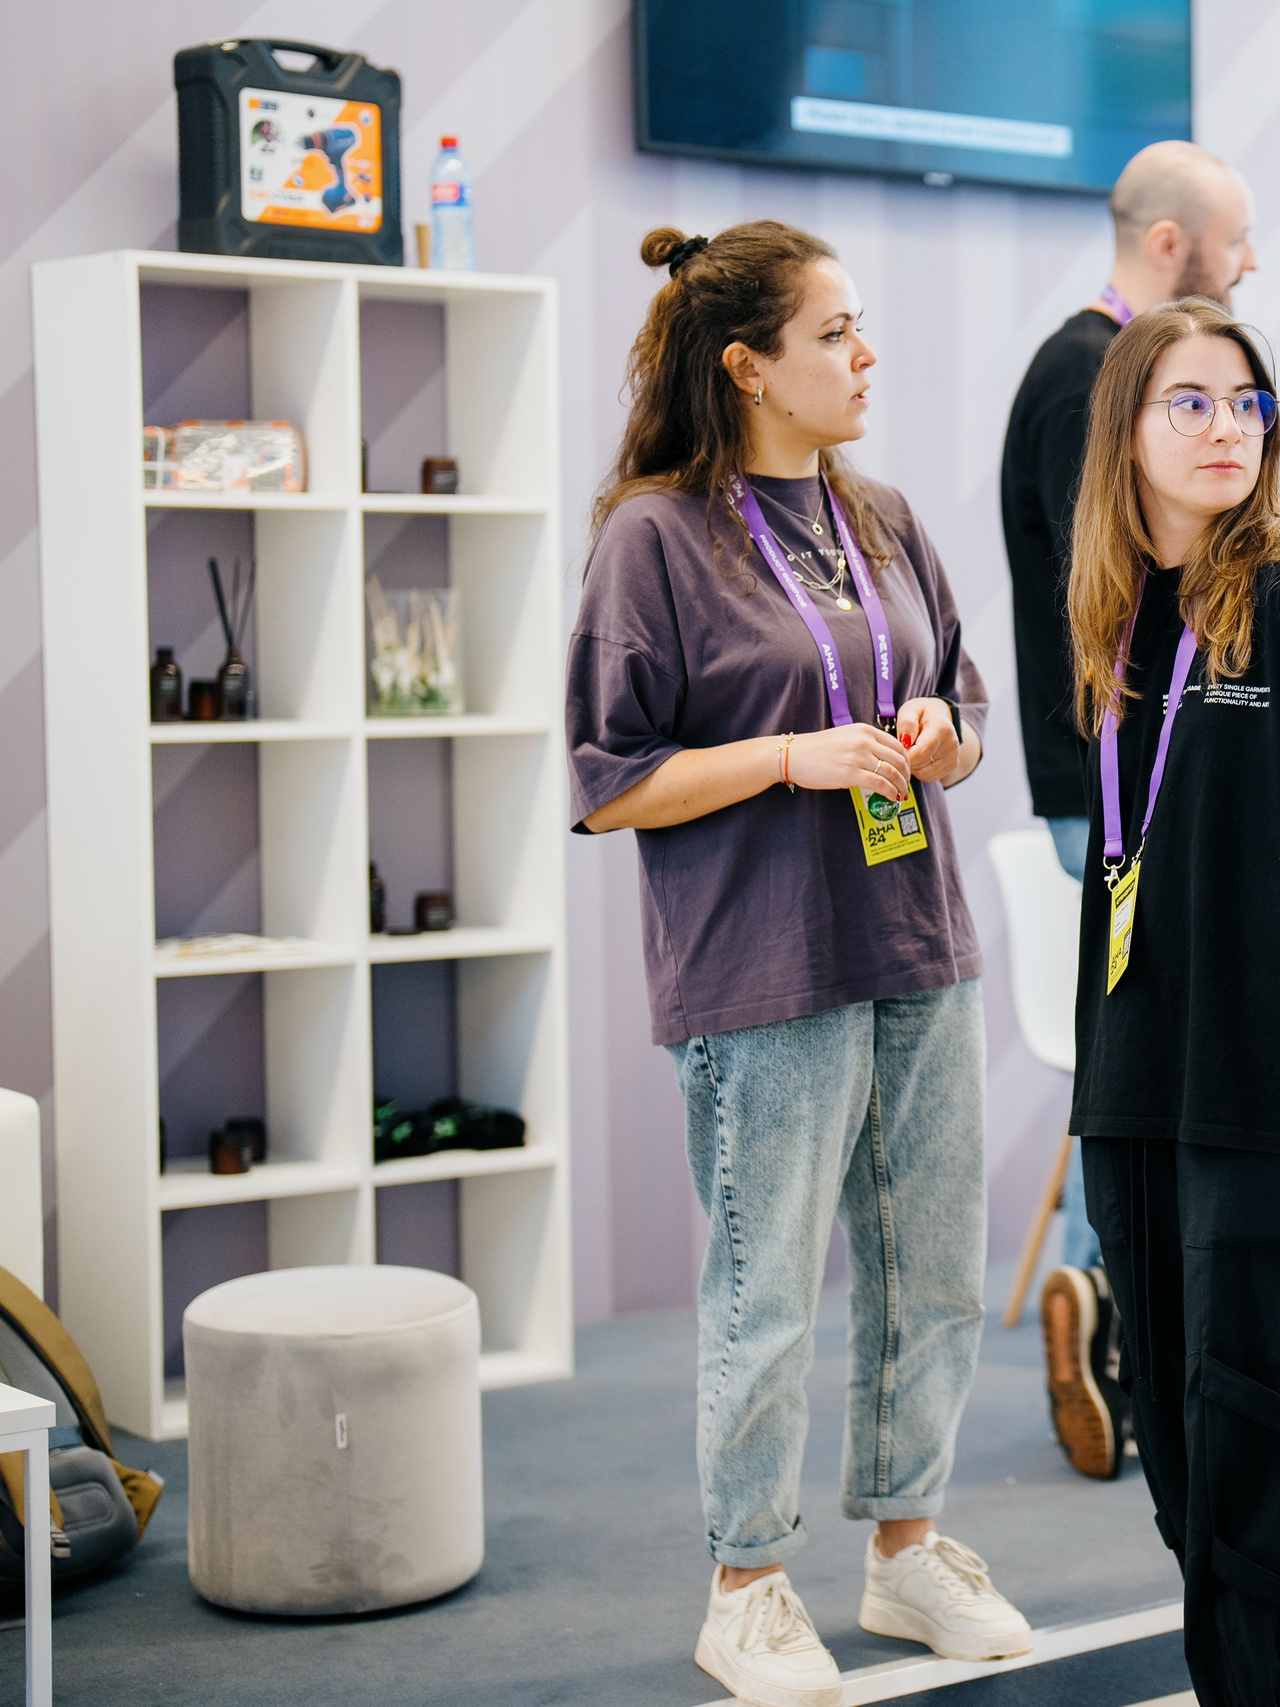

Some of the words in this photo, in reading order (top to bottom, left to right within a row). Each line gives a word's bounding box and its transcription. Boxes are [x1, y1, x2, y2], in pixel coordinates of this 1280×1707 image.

[759, 533, 786, 573] PRODUCT
[781, 572, 808, 608] SCIENCE
[877, 633, 889, 681] AHA'24
[821, 643, 840, 691] AHA'24
[1210, 690, 1232, 698] UNIQUE
[1223, 684, 1245, 692] SINGLE
[1203, 697, 1249, 707] FUNCTIONALITY
[868, 822, 896, 839] AHA
